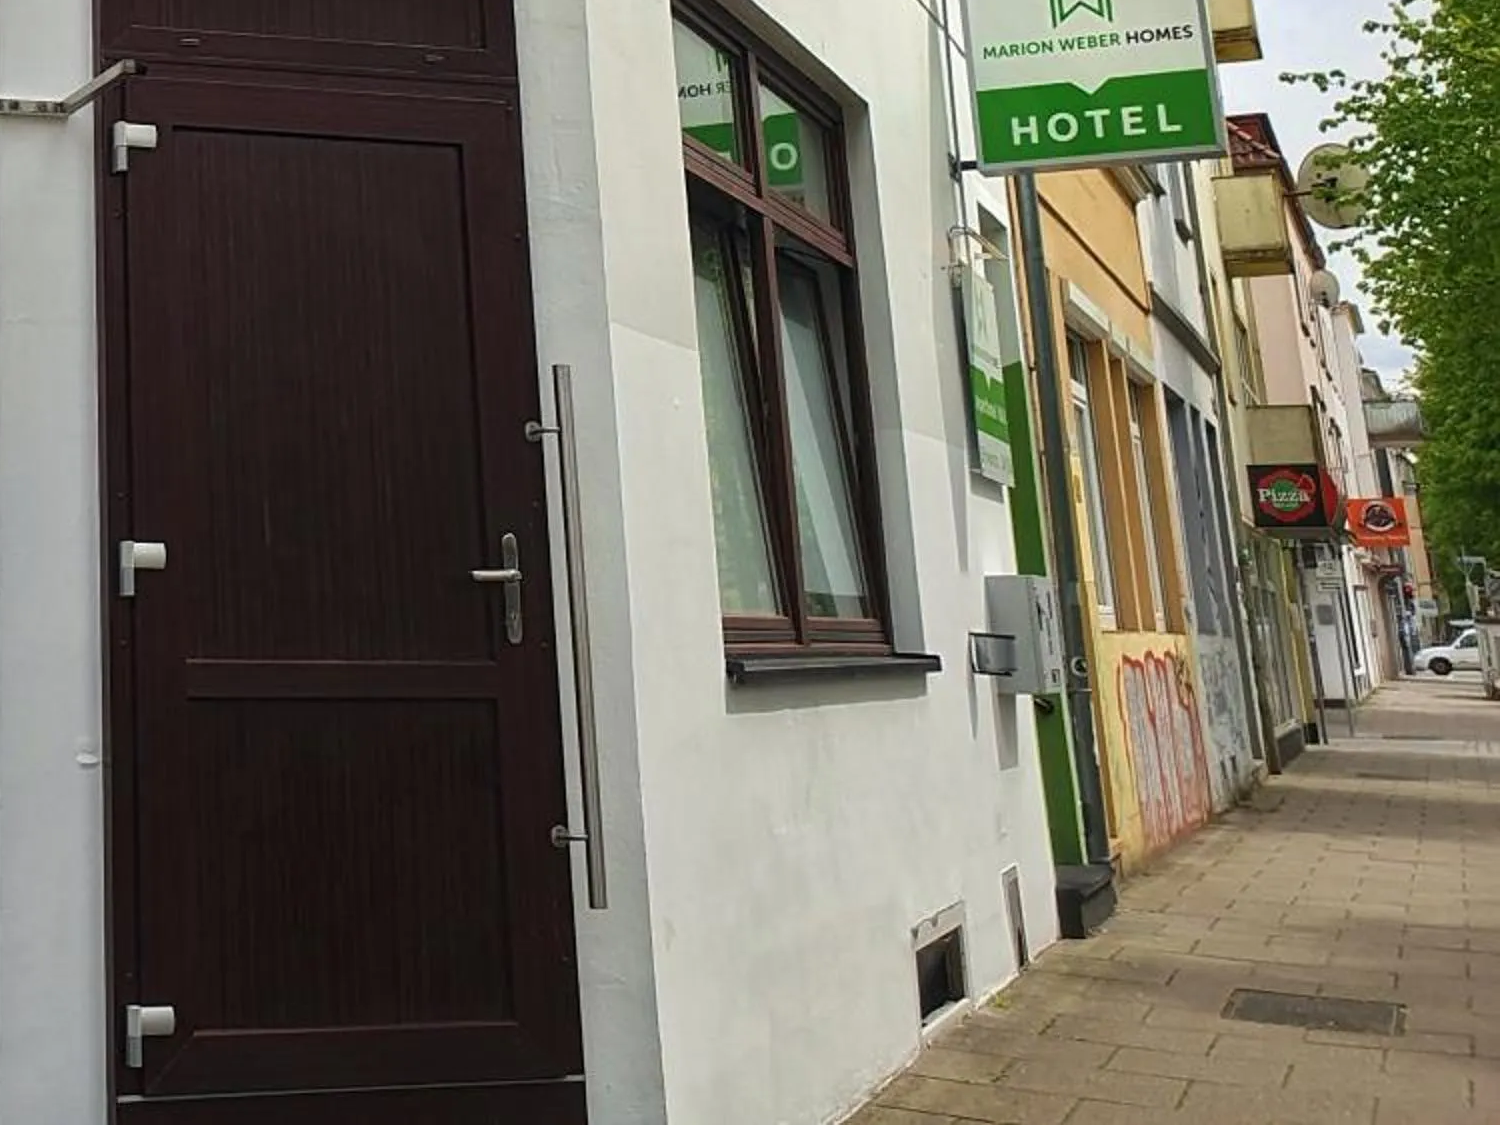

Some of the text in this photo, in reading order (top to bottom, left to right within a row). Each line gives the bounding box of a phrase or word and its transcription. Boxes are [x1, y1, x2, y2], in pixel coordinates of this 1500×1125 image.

[982, 24, 1194, 60] MARION WEBER HOMES
[1011, 103, 1183, 146] HOTEL
